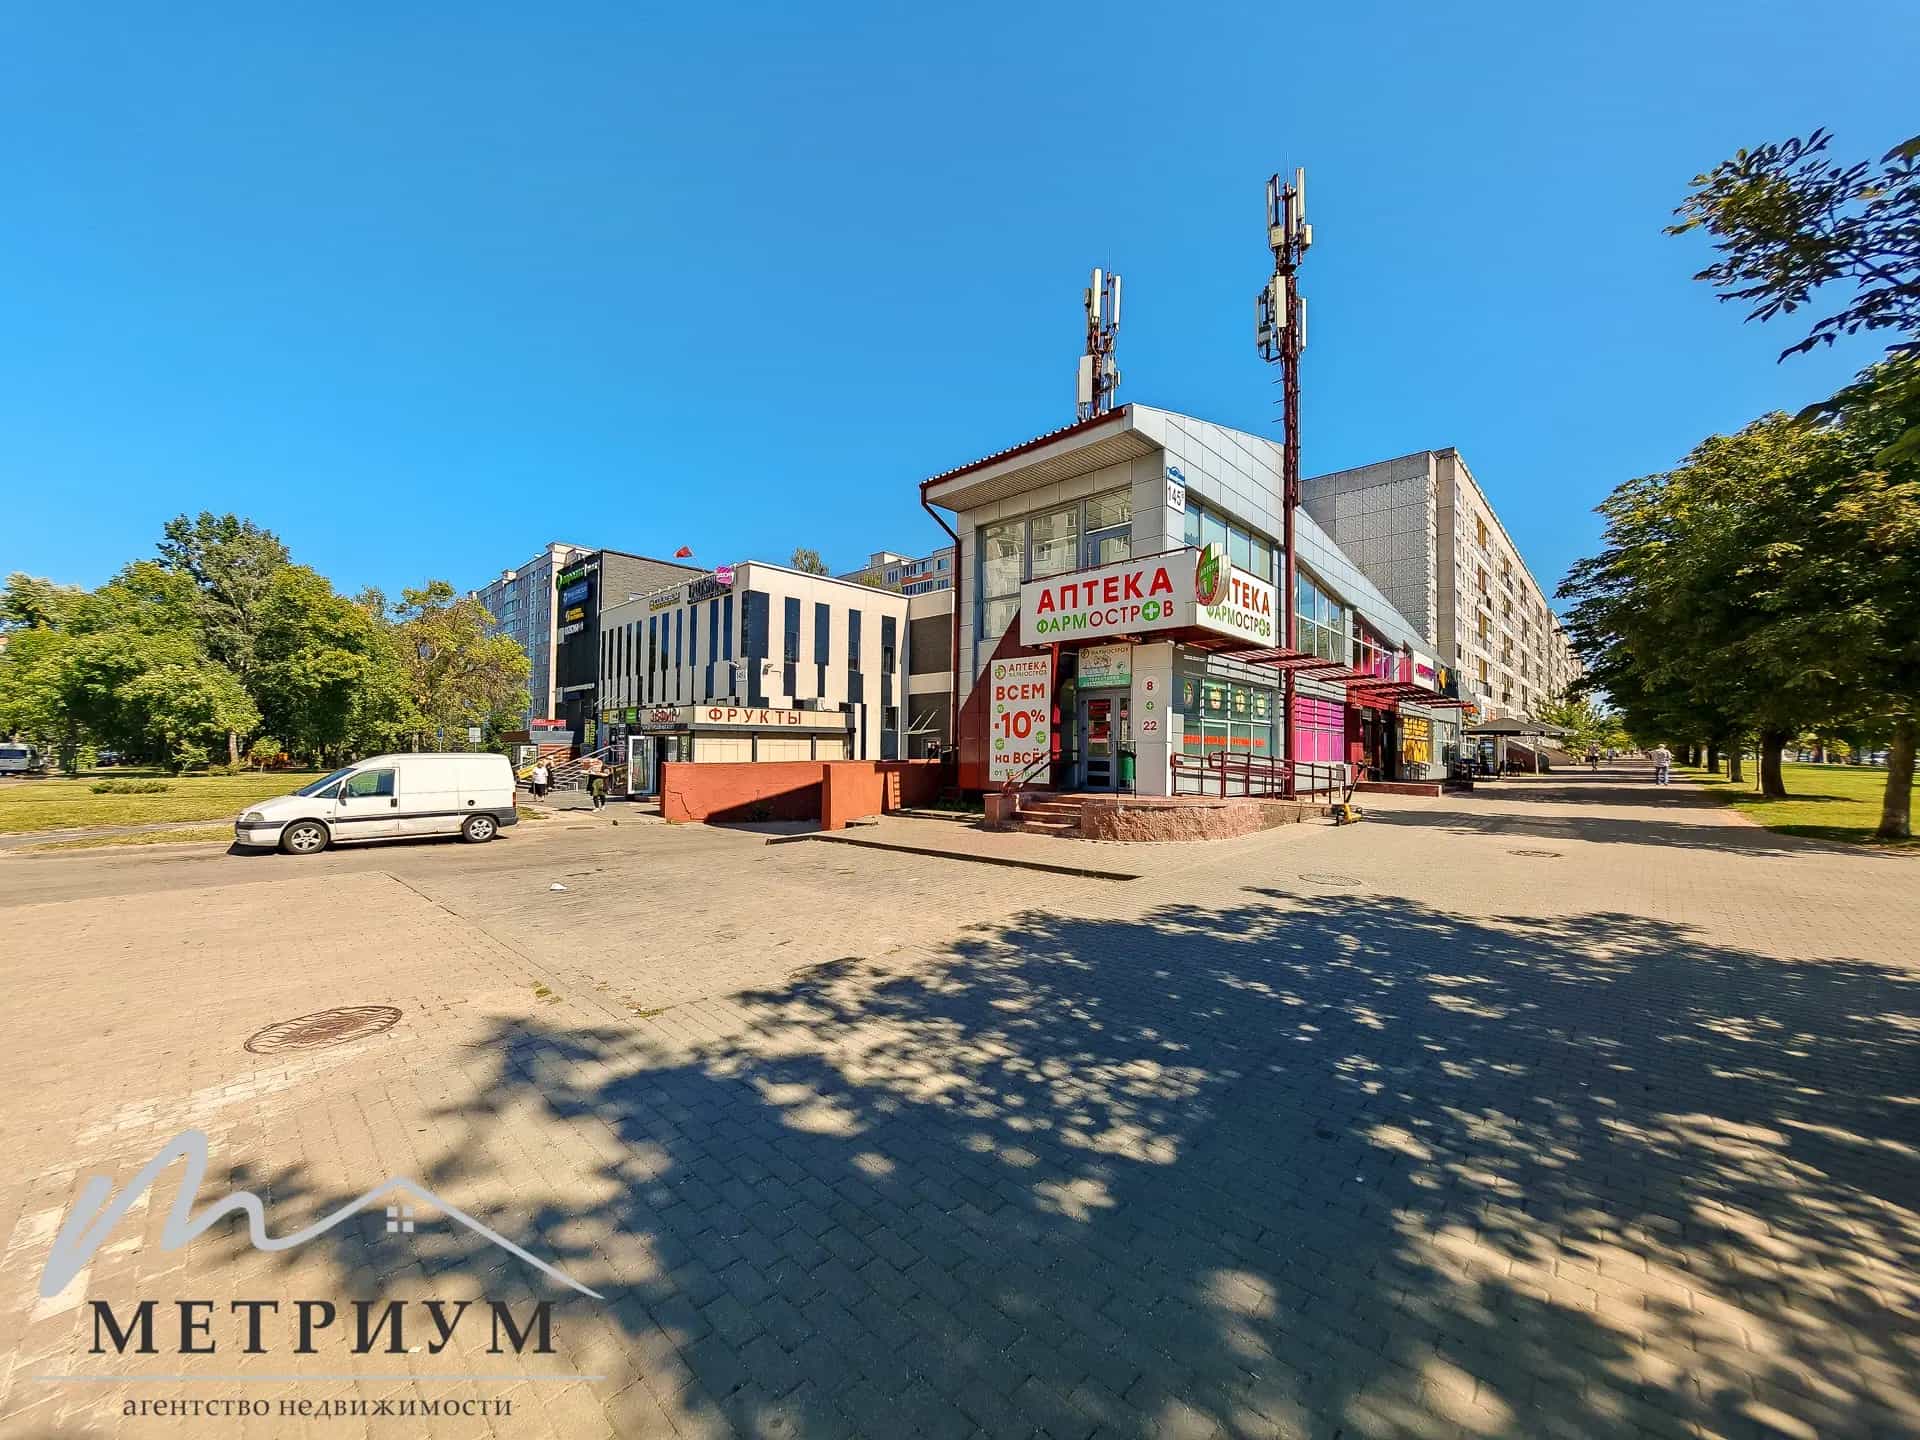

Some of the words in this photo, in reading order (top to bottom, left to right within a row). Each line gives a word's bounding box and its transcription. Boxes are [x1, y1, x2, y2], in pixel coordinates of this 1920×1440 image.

[1037, 567, 1174, 615] АПТЕКА
[1036, 600, 1174, 635] ФАРМОСТРОВ
[1009, 661, 1047, 672] АПТЕКА
[996, 683, 1045, 701] ВСЕМ
[1146, 681, 1153, 691] 8
[708, 707, 801, 725] ФРУКТЫ
[994, 708, 1046, 739] -10%
[1143, 721, 1157, 731] 22
[995, 754, 1010, 764] на
